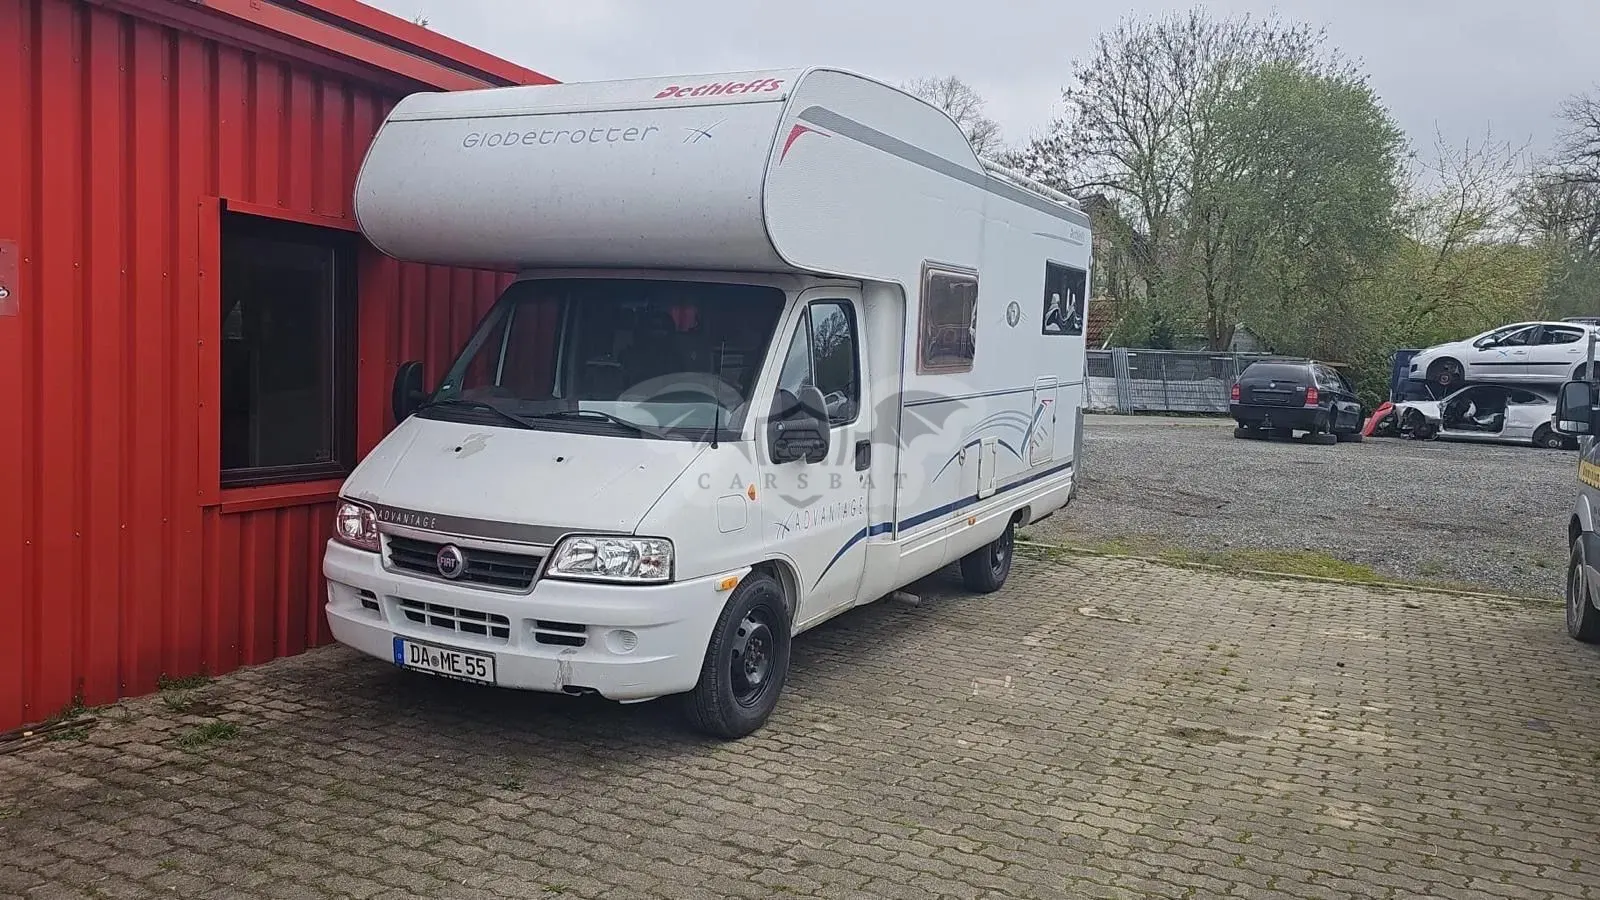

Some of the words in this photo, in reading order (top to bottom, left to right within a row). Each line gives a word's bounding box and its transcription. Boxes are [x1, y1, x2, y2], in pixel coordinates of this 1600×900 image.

[654, 79, 784, 99] Dethleffs
[463, 126, 660, 148] Globetrotter
[378, 509, 437, 529] ADVANTAGE
[795, 495, 864, 531] ADVANTAGE
[440, 556, 456, 568] FIAT
[410, 644, 430, 667] DA
[440, 650, 462, 674] ME
[465, 655, 487, 677] 55
